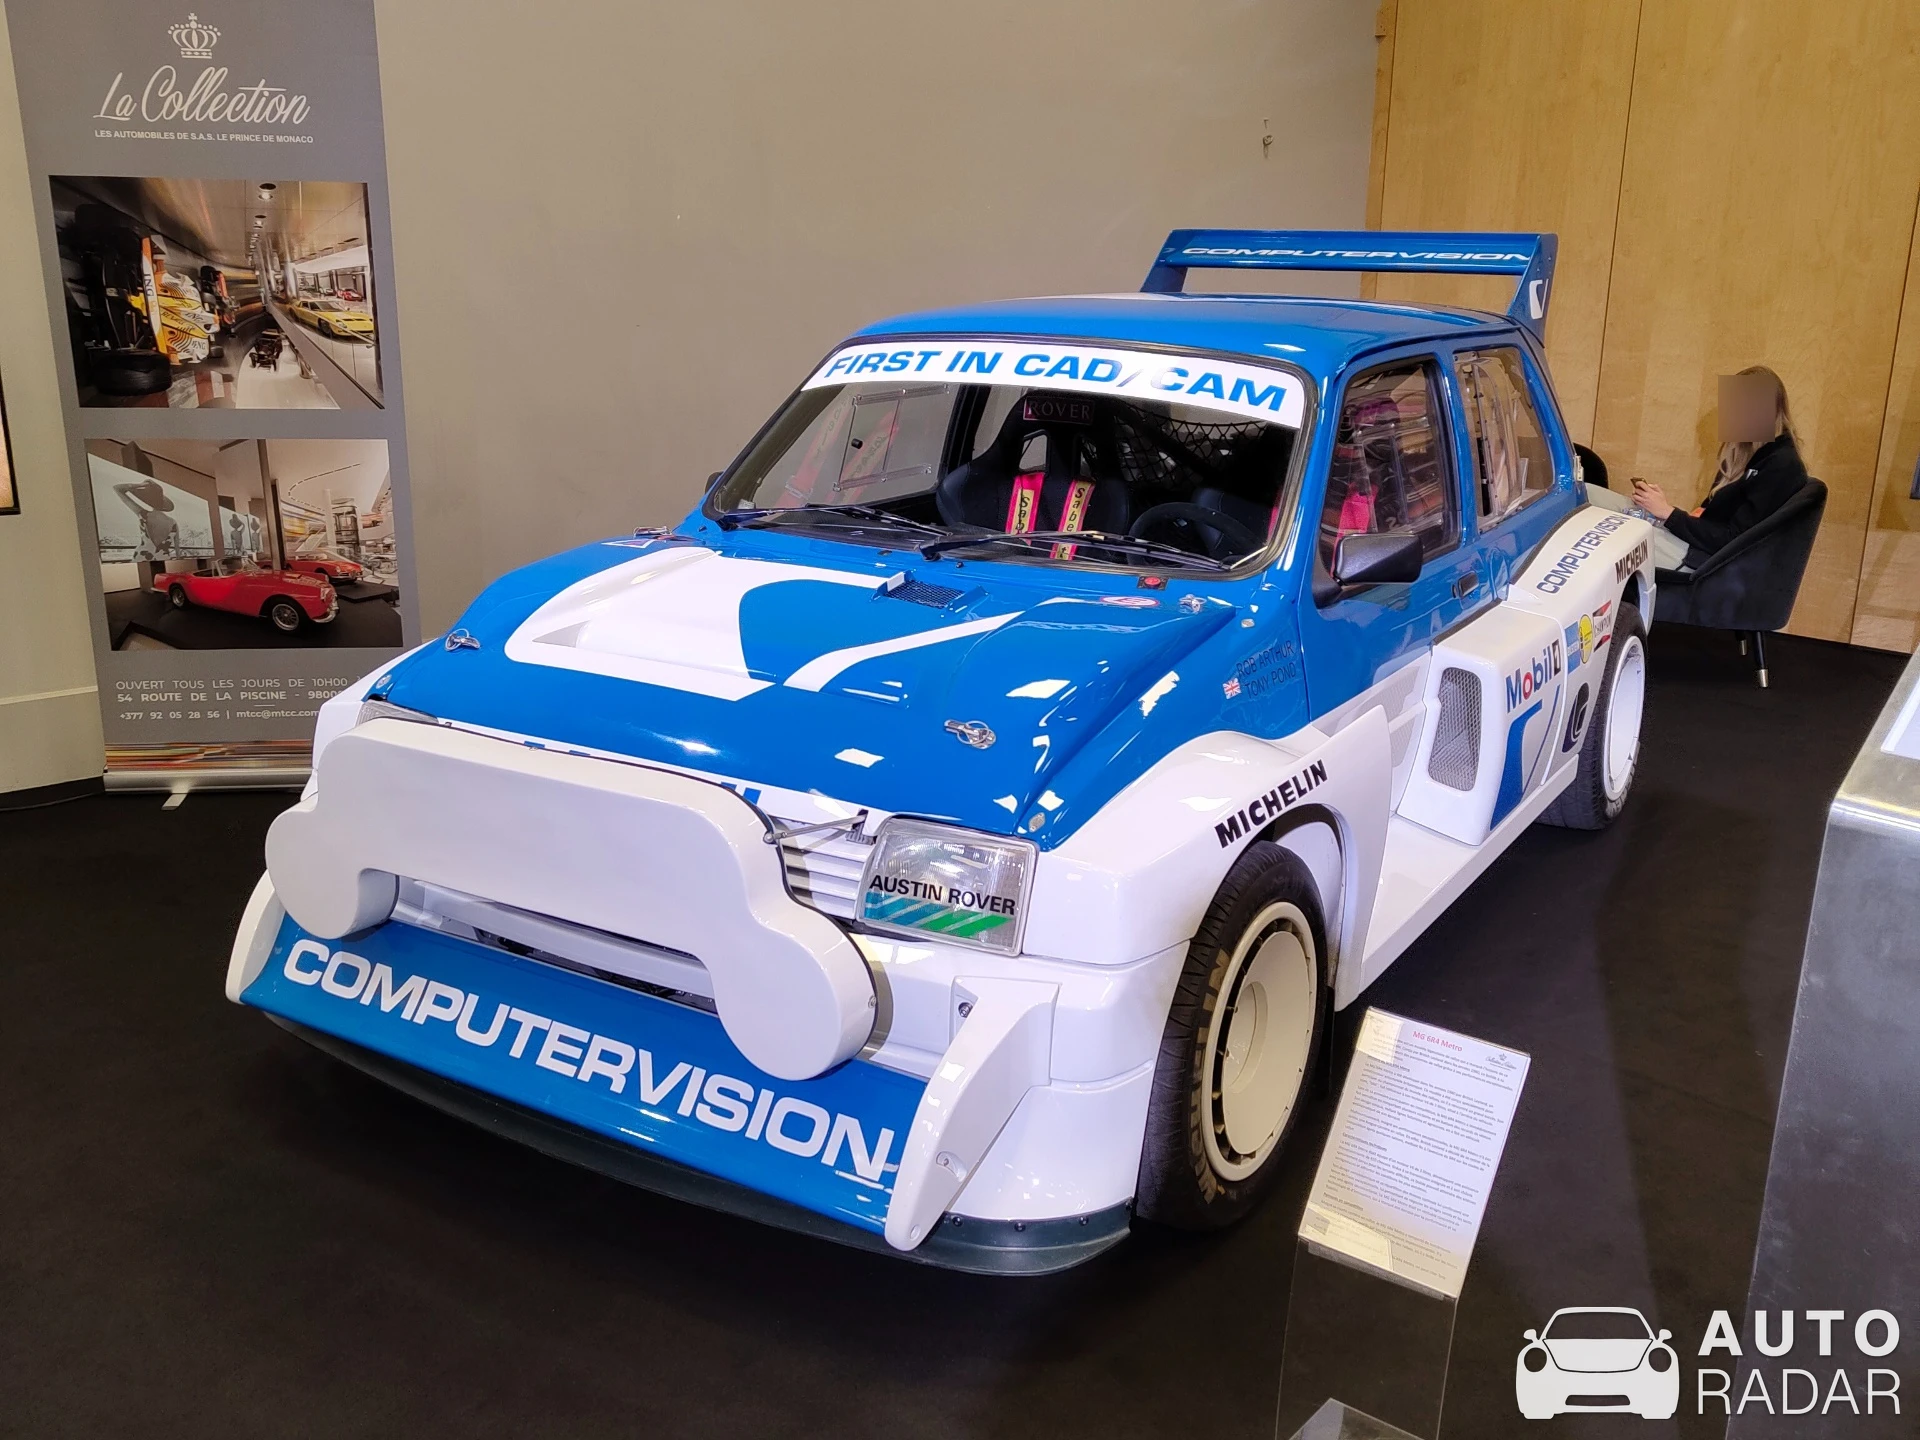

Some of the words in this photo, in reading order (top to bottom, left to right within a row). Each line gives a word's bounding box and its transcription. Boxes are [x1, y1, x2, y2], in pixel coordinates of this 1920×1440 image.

[93, 72, 137, 121] La
[141, 65, 310, 125] Collection
[94, 129, 112, 138] LES
[113, 130, 176, 140] AUTOMOBILES
[177, 131, 189, 140] DE
[190, 132, 215, 141] S.A.S.
[217, 133, 228, 142] LE
[229, 133, 261, 142] PRINCE
[262, 134, 275, 143] DE
[276, 135, 314, 144] MONACO
[1182, 247, 1530, 261] COMPUTERVISION
[824, 350, 942, 378] FIRST
[947, 351, 1003, 374] IN
[1014, 353, 1289, 412] CAD/CAM
[1027, 400, 1090, 420] ROVER
[1536, 513, 1631, 594] COMPUTERVISION
[1615, 538, 1649, 585] MICHELIN
[1236, 656, 1257, 678] ROB
[1259, 639, 1295, 667] ARTHUR
[115, 680, 165, 690] OUVERT
[172, 680, 205, 689] TOUS
[212, 679, 235, 689] LES
[241, 678, 281, 688] JOURS
[288, 678, 305, 688] DE
[311, 677, 348, 687] 10H00
[117, 693, 133, 703] 54
[140, 692, 183, 702] ROUTE
[190, 692, 208, 702] DE
[215, 691, 233, 701] LA
[240, 691, 287, 700] PISCINE
[1244, 675, 1272, 699] TONY
[1271, 662, 1297, 686] POND
[1505, 645, 1552, 713] Mobil
[119, 711, 144, 720] +377
[149, 711, 163, 720] 92
[169, 711, 182, 719] 05
[188, 710, 201, 719] 28
[207, 710, 220, 719] 56
[1214, 759, 1328, 850] MICHELIN
[869, 874, 942, 902] AUSTIN
[948, 889, 1016, 916] ROVER
[282, 938, 895, 1181] COMPUTERVISION
[1412, 1030, 1426, 1040] MG
[1426, 1035, 1440, 1046] 6R4
[1440, 1039, 1463, 1052] Metro
